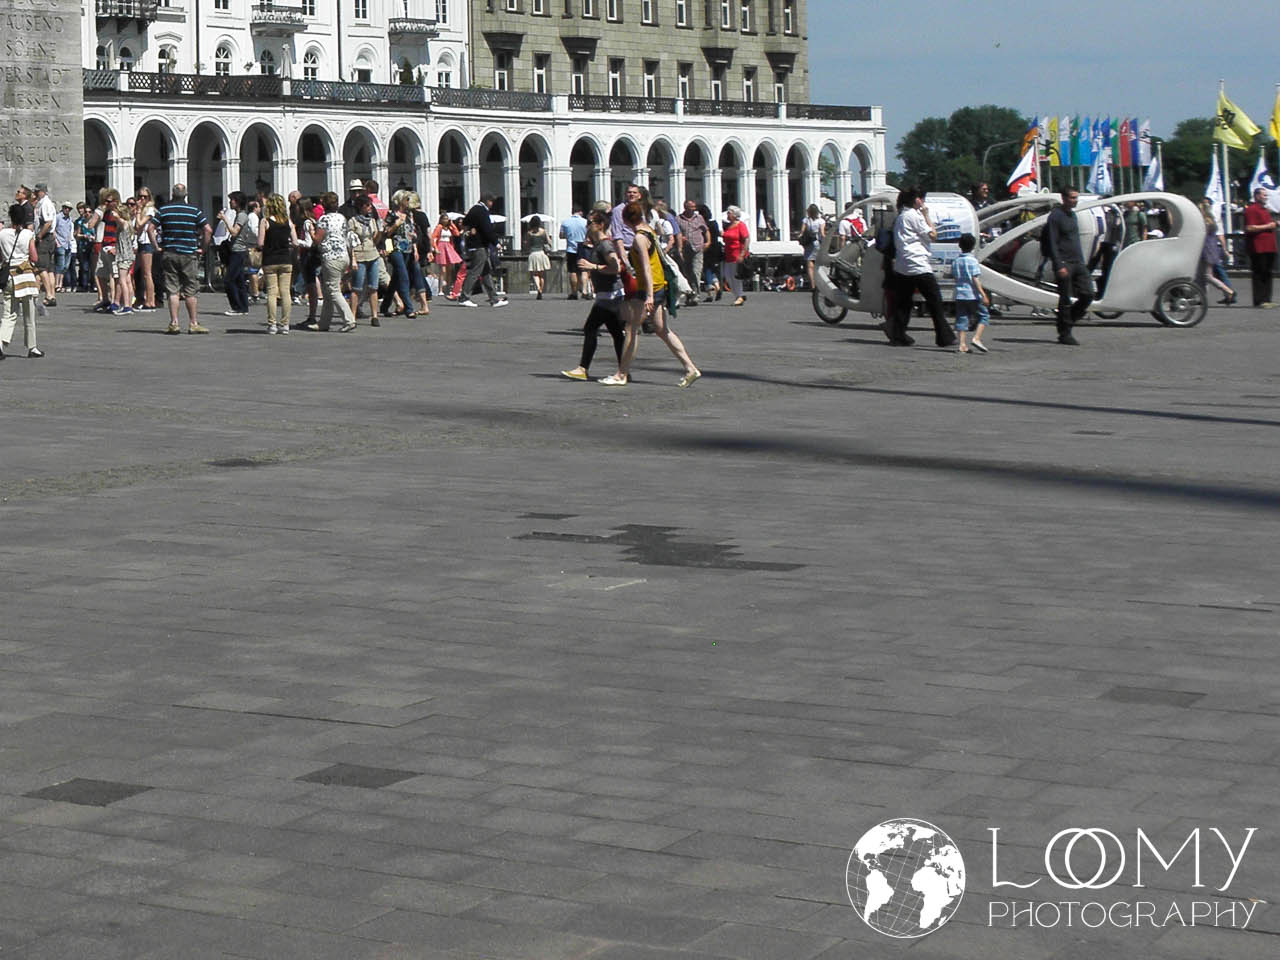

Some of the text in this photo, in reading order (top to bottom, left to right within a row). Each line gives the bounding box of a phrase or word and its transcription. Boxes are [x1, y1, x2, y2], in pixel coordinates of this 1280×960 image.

[6, 37, 57, 59] SÖHNE
[26, 67, 71, 85] STADT
[25, 120, 71, 137] LEBEN
[28, 146, 69, 163] EUCH
